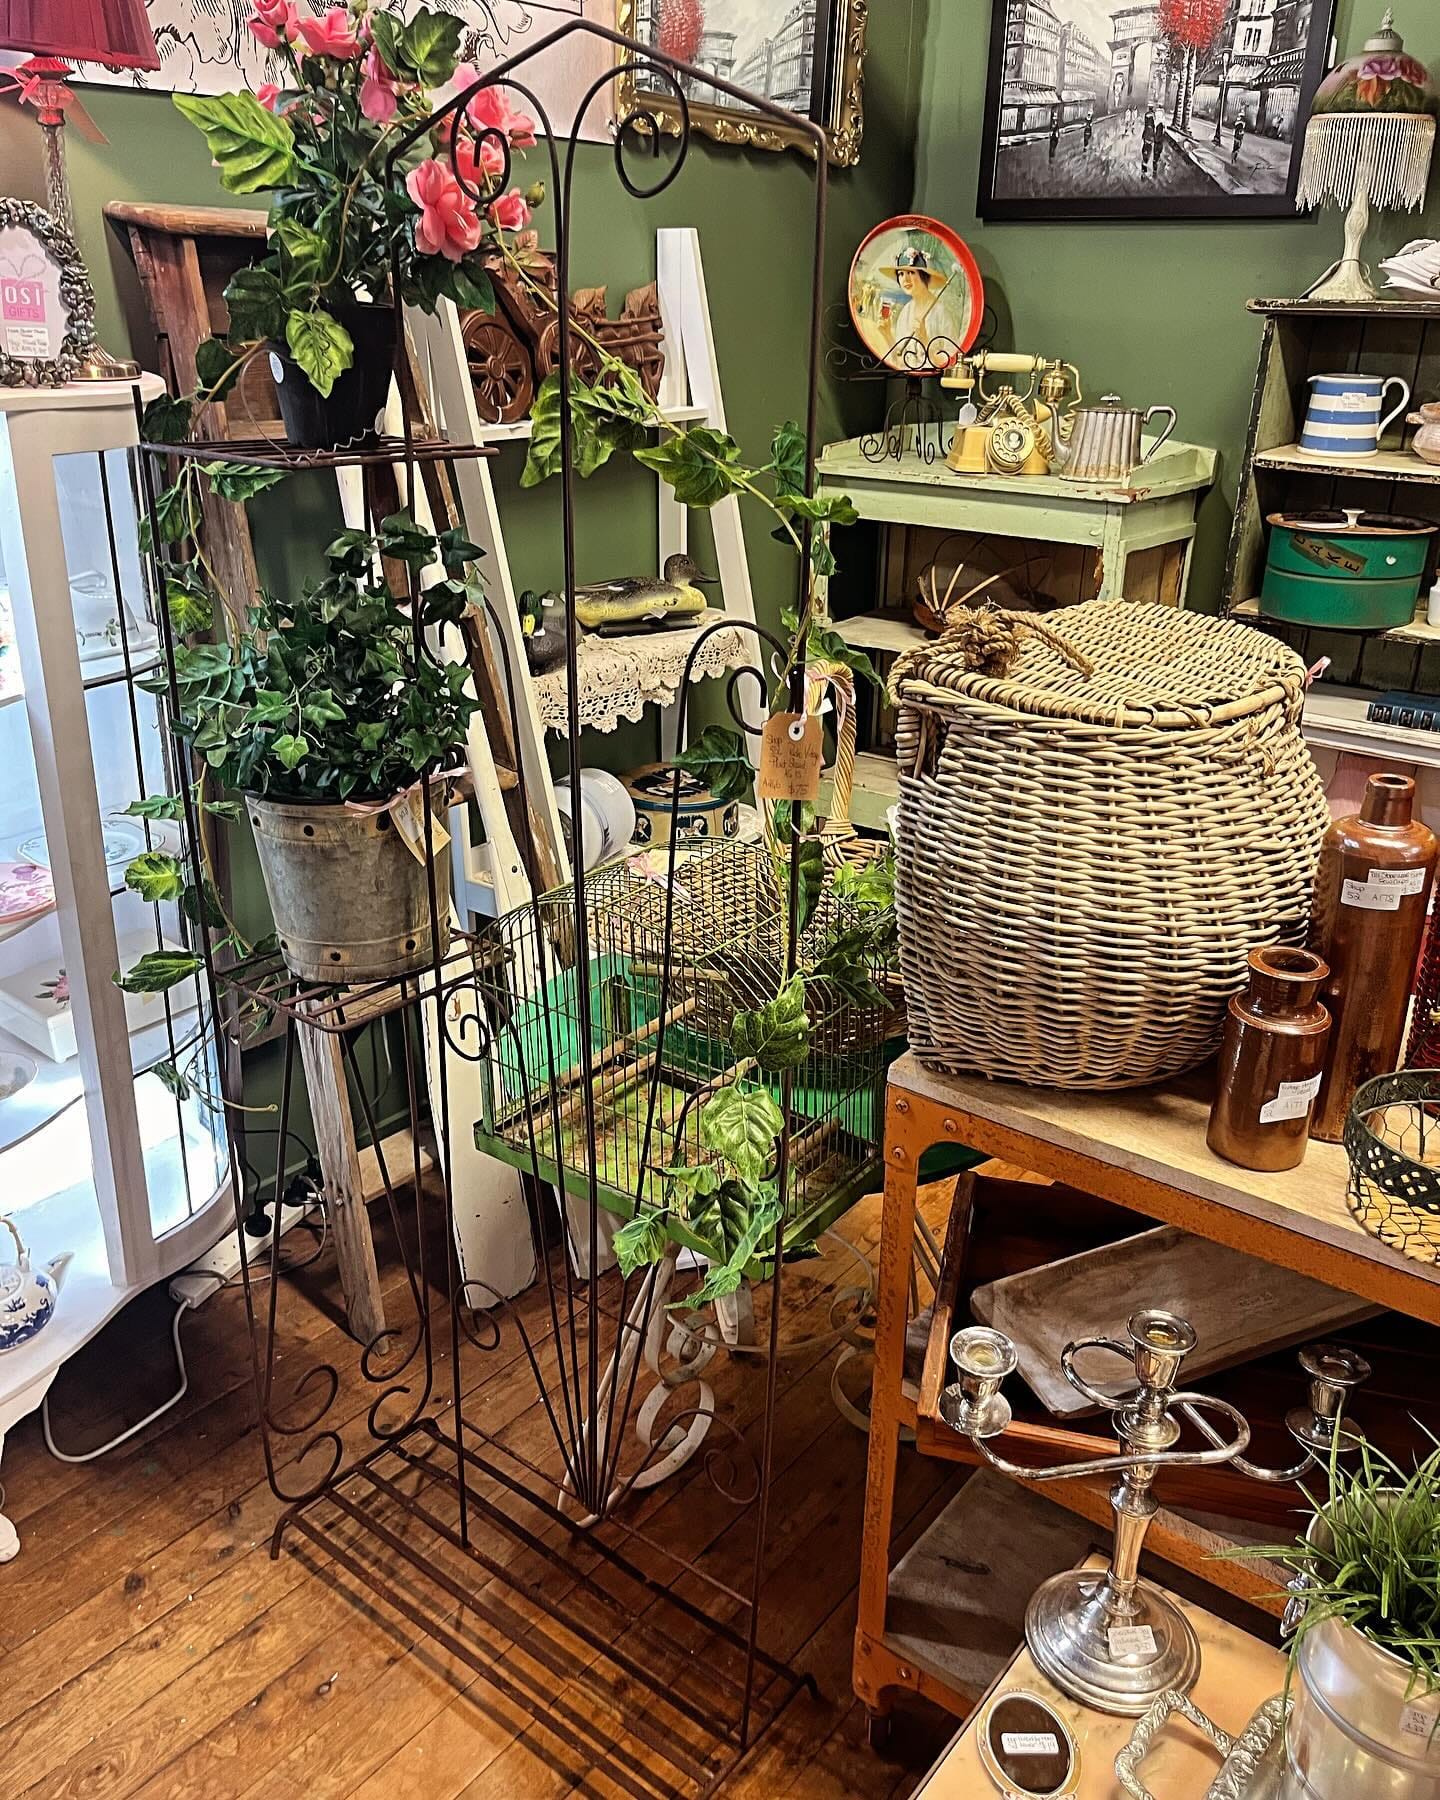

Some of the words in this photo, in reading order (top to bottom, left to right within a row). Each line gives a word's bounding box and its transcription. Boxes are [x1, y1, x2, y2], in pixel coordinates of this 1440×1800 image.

[9, 305, 40, 318] GIFTS
[1294, 533, 1361, 572] CAKE
[1372, 894, 1394, 903] A178
